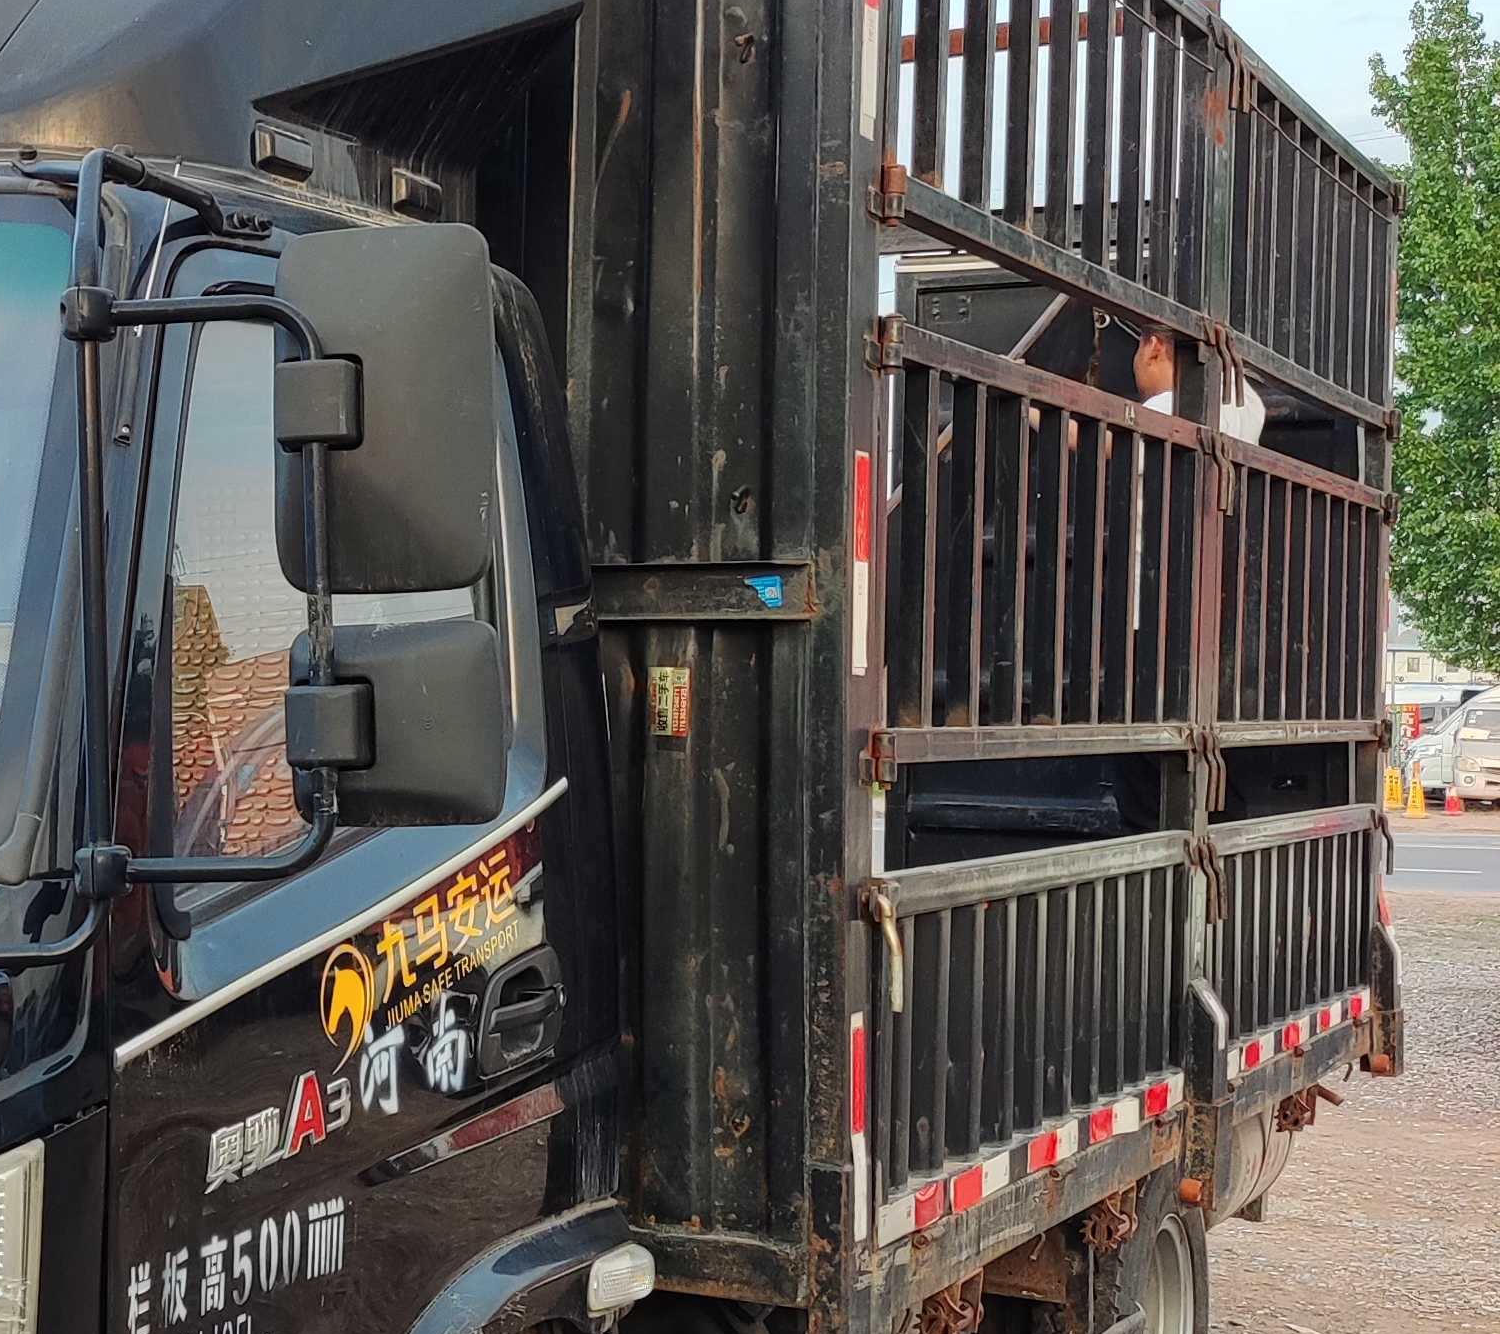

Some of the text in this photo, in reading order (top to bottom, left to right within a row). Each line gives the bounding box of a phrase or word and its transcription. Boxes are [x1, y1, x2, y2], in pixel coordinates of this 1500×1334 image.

[376, 848, 517, 1004] 九马安运
[384, 919, 520, 1032] JIUMA SAFE TRANSPORT
